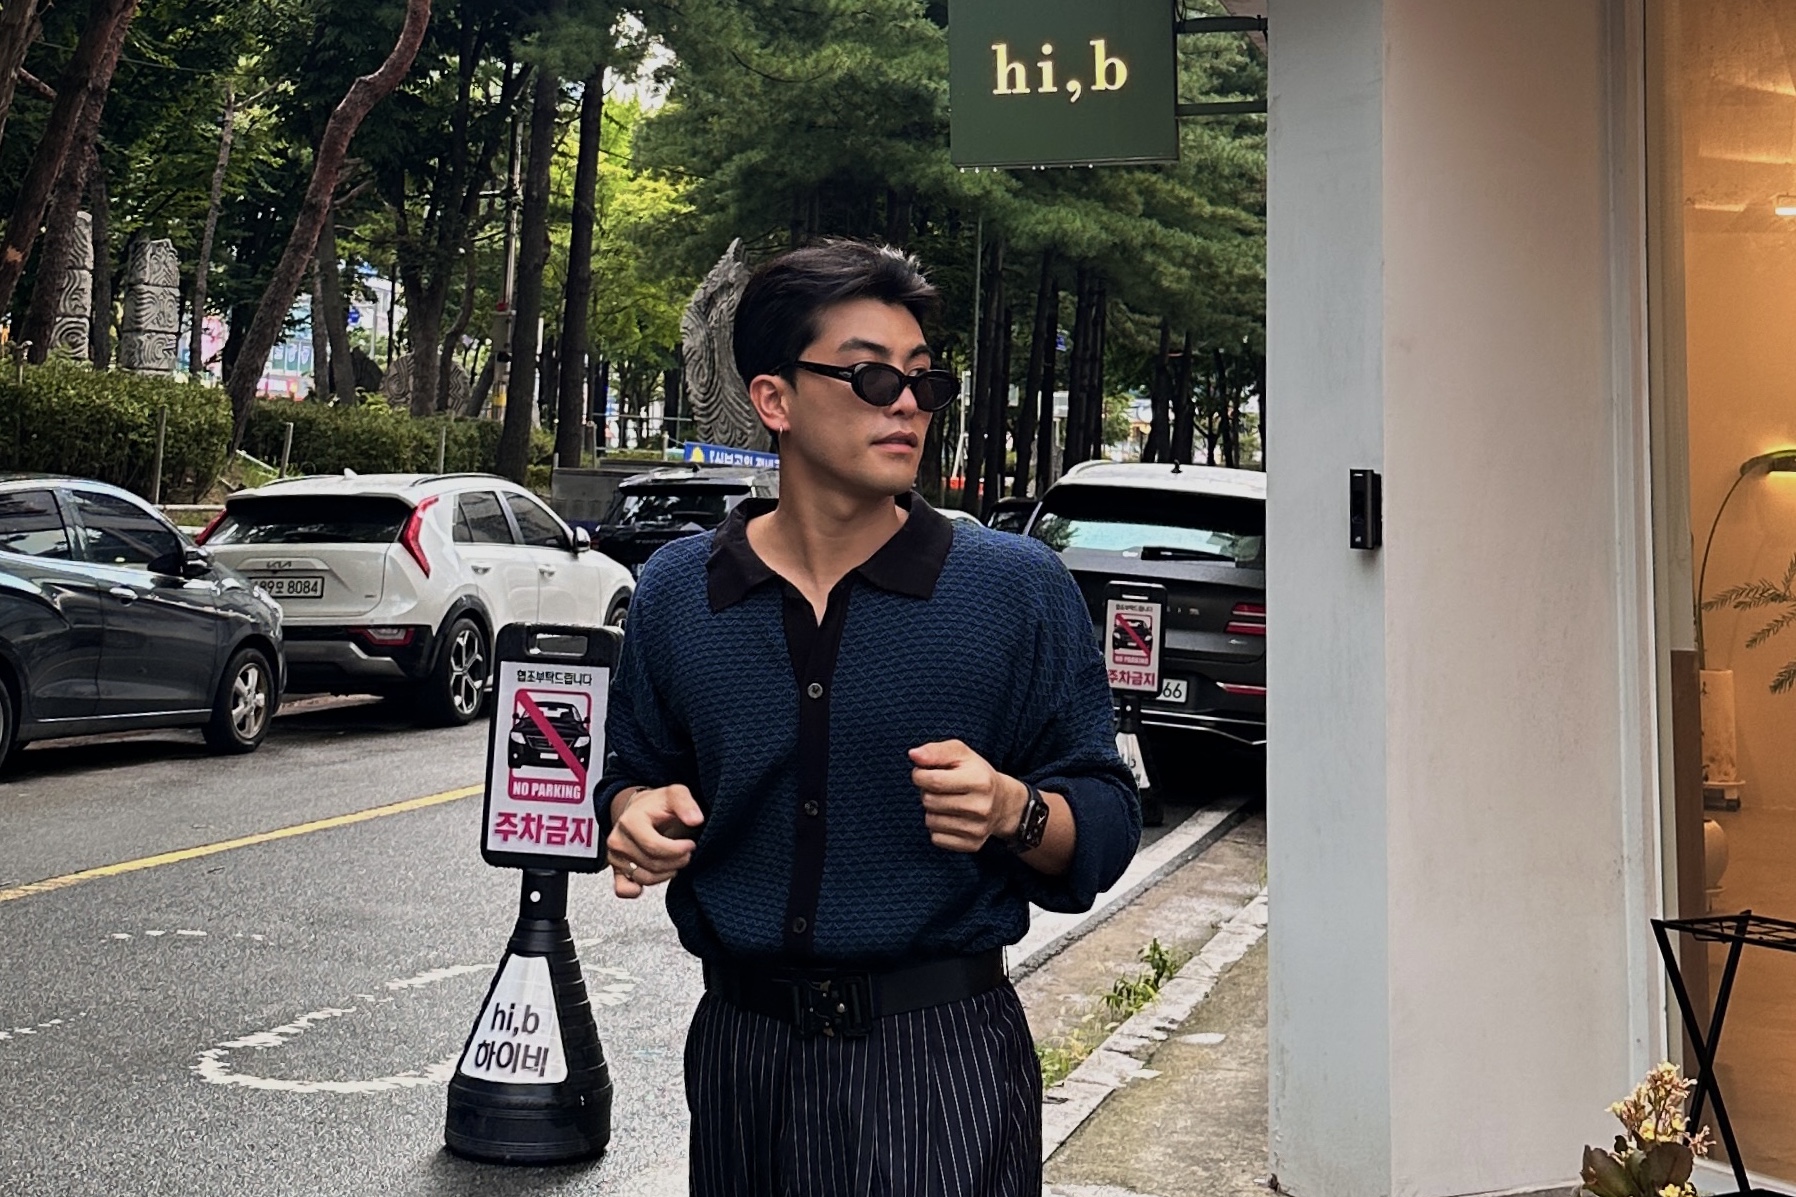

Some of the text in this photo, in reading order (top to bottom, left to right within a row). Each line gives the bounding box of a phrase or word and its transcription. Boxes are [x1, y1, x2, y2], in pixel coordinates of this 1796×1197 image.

[991, 39, 1128, 103] hi,b
[287, 580, 318, 594] 8084
[1108, 669, 1156, 687] 주차금지
[1162, 681, 1183, 699] 66
[512, 781, 582, 800] NO PARKING
[493, 811, 594, 848] 주차금지
[490, 1002, 540, 1038] hi,b
[474, 1039, 549, 1077] 하이비
